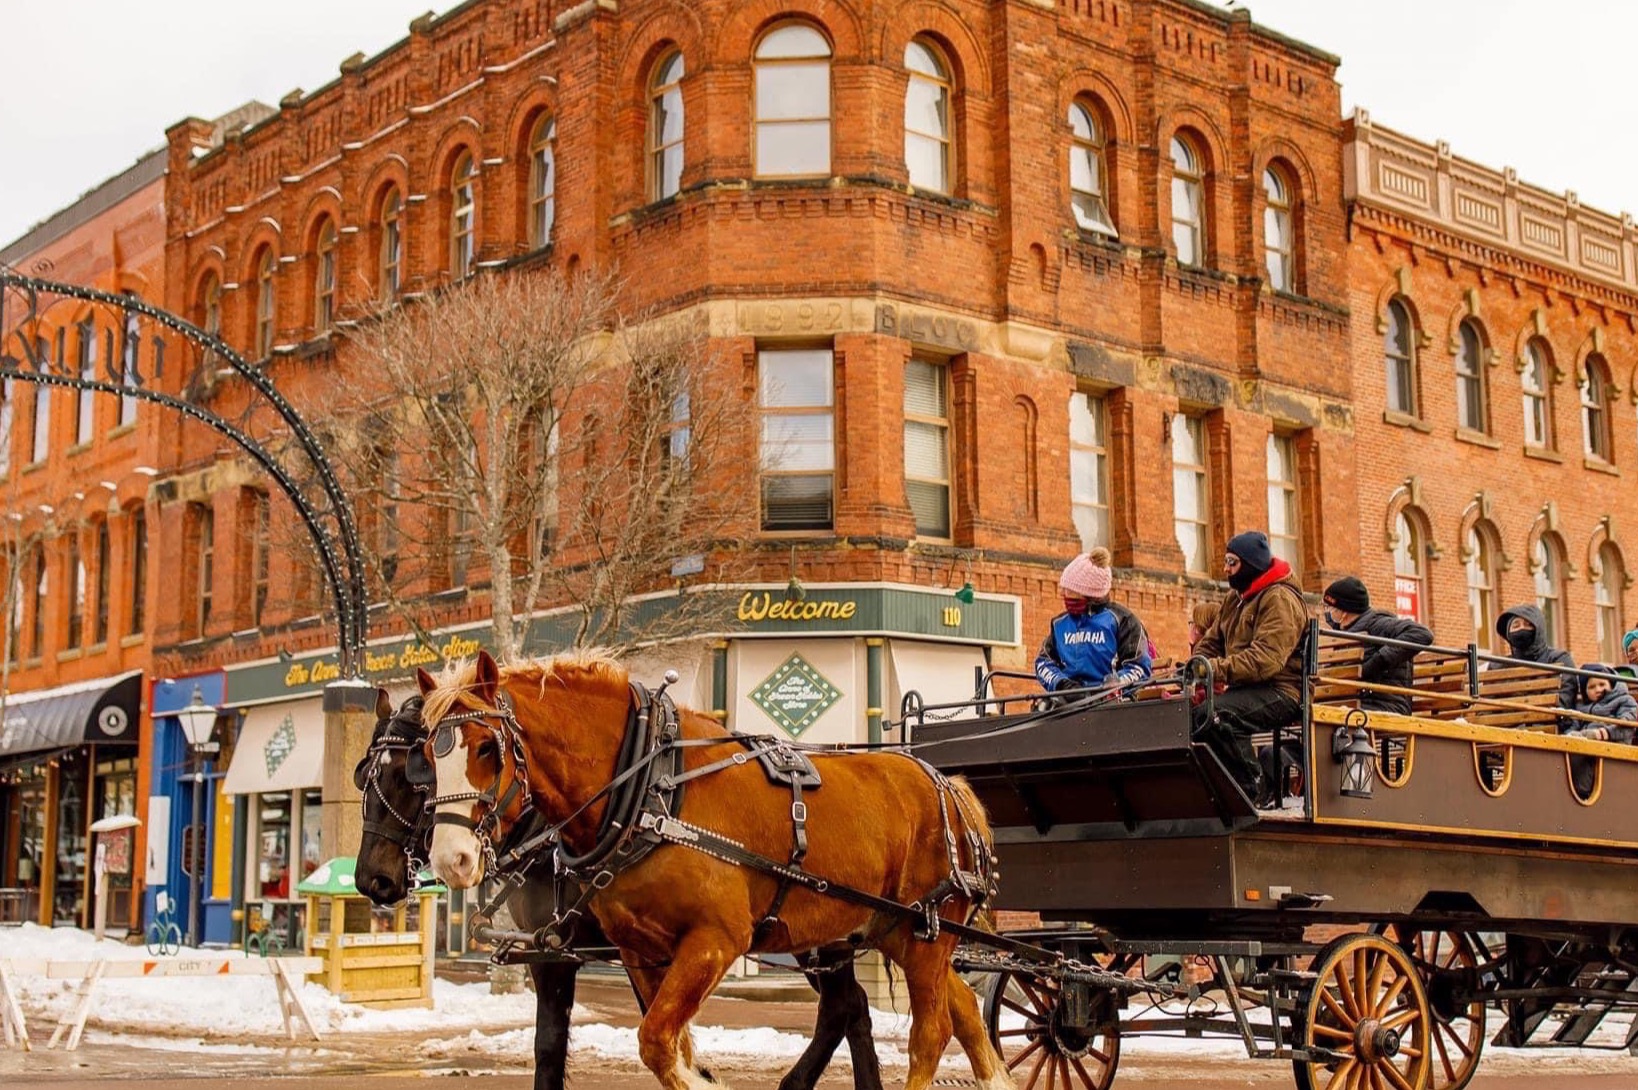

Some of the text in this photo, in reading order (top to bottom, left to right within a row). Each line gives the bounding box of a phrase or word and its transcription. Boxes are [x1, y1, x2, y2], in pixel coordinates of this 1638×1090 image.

[738, 591, 857, 621] Welcome
[942, 607, 961, 627] 110
[1063, 631, 1106, 645] YAMAHA
[178, 961, 201, 971] CITY
